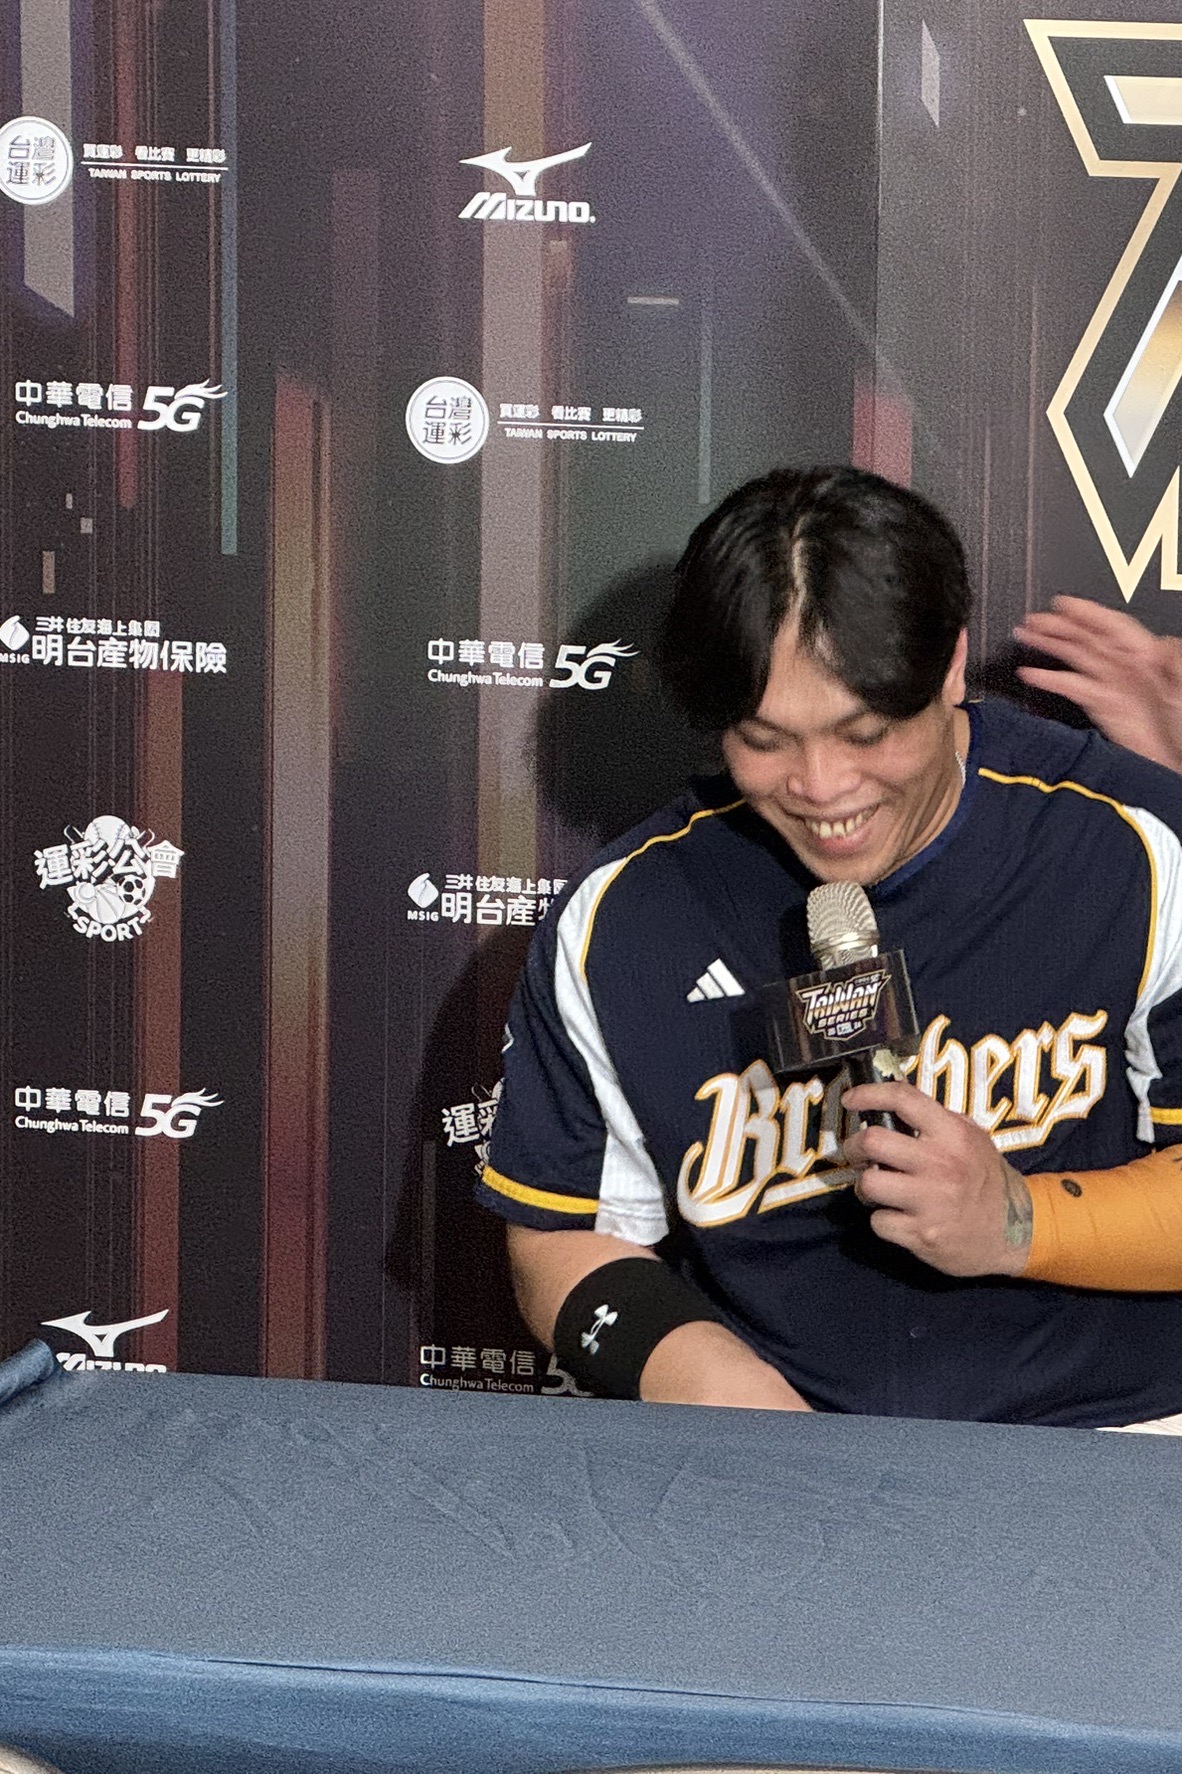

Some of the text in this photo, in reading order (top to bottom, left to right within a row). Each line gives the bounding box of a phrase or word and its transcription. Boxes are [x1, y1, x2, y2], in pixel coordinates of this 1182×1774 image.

[8, 135, 56, 160] 台灣
[7, 161, 56, 186] 運彩
[88, 168, 221, 183] TAIWAN SPORTS LOTTERY
[15, 379, 133, 411] 中華電信
[425, 395, 472, 420] 台灣
[15, 411, 132, 429] Chunghwa Telecom
[137, 384, 208, 432] 5G
[423, 421, 472, 445] 運彩
[504, 427, 637, 443] TAIWAN SPORTS LOTTERY
[428, 638, 546, 669] 中華電信
[428, 669, 544, 687] Chunghwa Telecom
[549, 643, 618, 690] 5G
[34, 838, 185, 890] 運彩公會
[73, 915, 143, 942] SPORT
[407, 910, 440, 922] MSIG
[818, 1007, 869, 1029] SERIES
[15, 1085, 131, 1117] 中華電信
[15, 1115, 129, 1134] Chunghwa Telecom
[135, 1092, 203, 1138] 5G
[678, 1009, 1108, 1227] Brhers
[420, 1344, 536, 1376] 中華電信
[420, 1373, 534, 1393] Chunghwa Telecom
